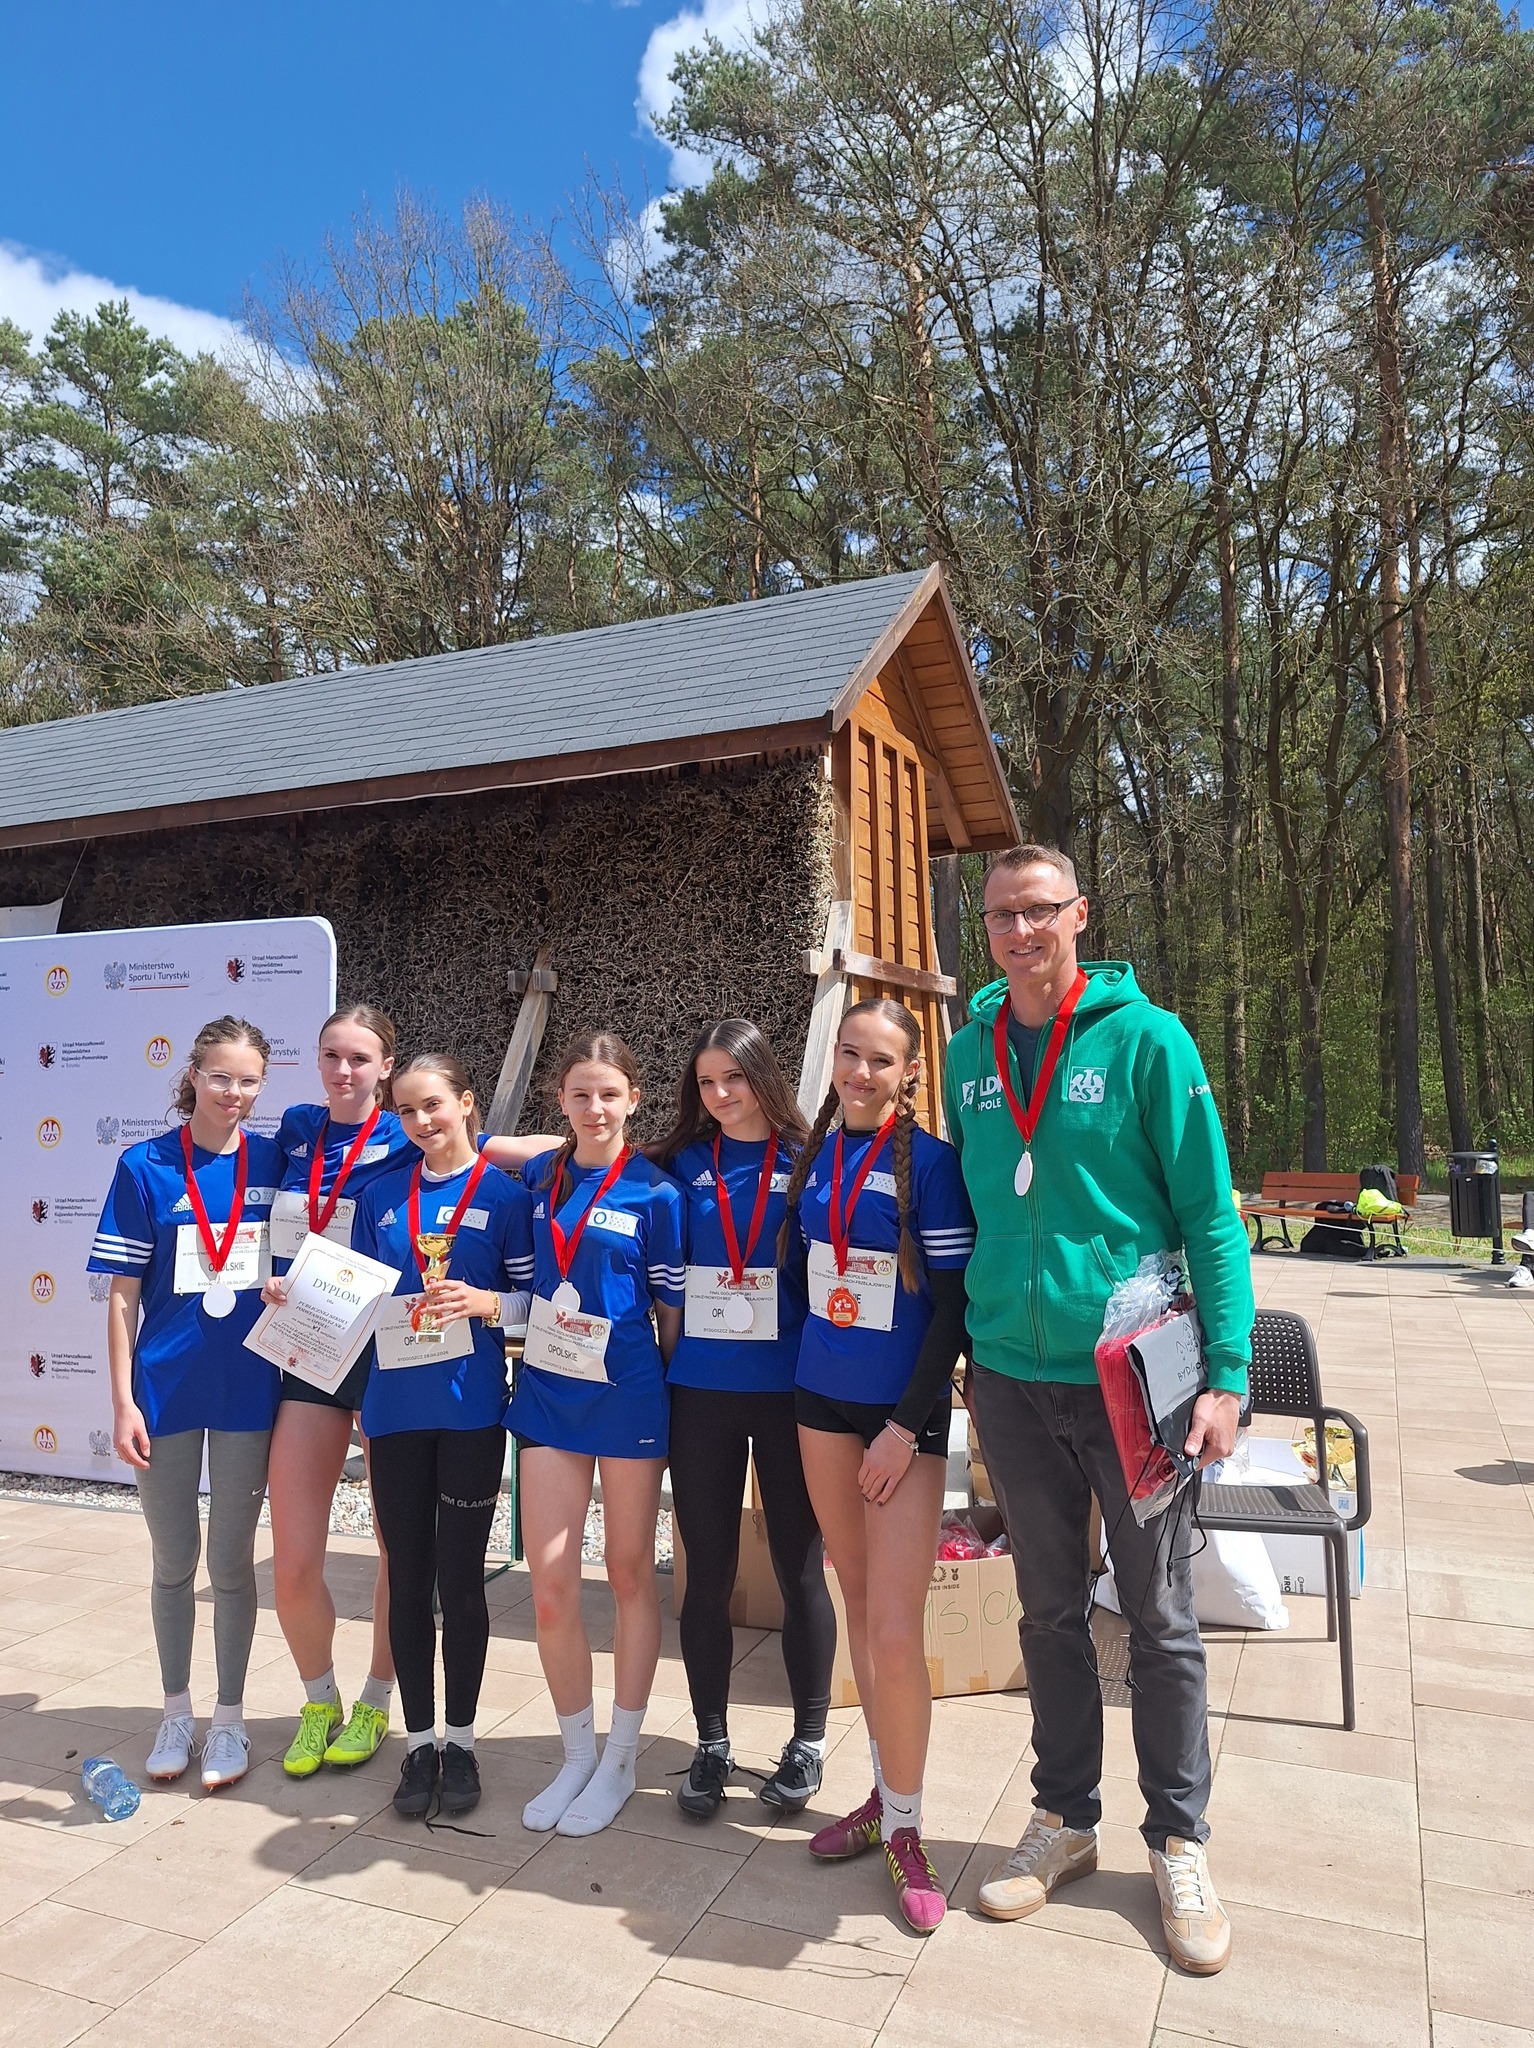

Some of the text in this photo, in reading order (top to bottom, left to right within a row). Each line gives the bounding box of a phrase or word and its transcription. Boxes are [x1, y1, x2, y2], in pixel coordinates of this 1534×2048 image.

[129, 962, 175, 971] Ministerstwo
[128, 972, 152, 982] Sportu
[158, 971, 190, 981] Turystyki
[50, 981, 66, 990] SZS
[151, 1052, 168, 1061] SZS
[270, 1048, 301, 1057] urystyki
[980, 1074, 1003, 1097] LD
[42, 1134, 58, 1142] SZS
[121, 1129, 145, 1138] Sportu
[172, 1203, 194, 1213] adid
[207, 1260, 245, 1272] OOLSKIE
[36, 1288, 51, 1297] SZS
[311, 1277, 362, 1306] DYPLOM
[397, 1349, 449, 1362] BYDGOSZCZ 28.04.2026
[546, 1342, 578, 1362] OPOLSKIE
[51, 1367, 96, 1375] Kujawsko-Pomorskiego
[39, 1441, 54, 1449] SZS
